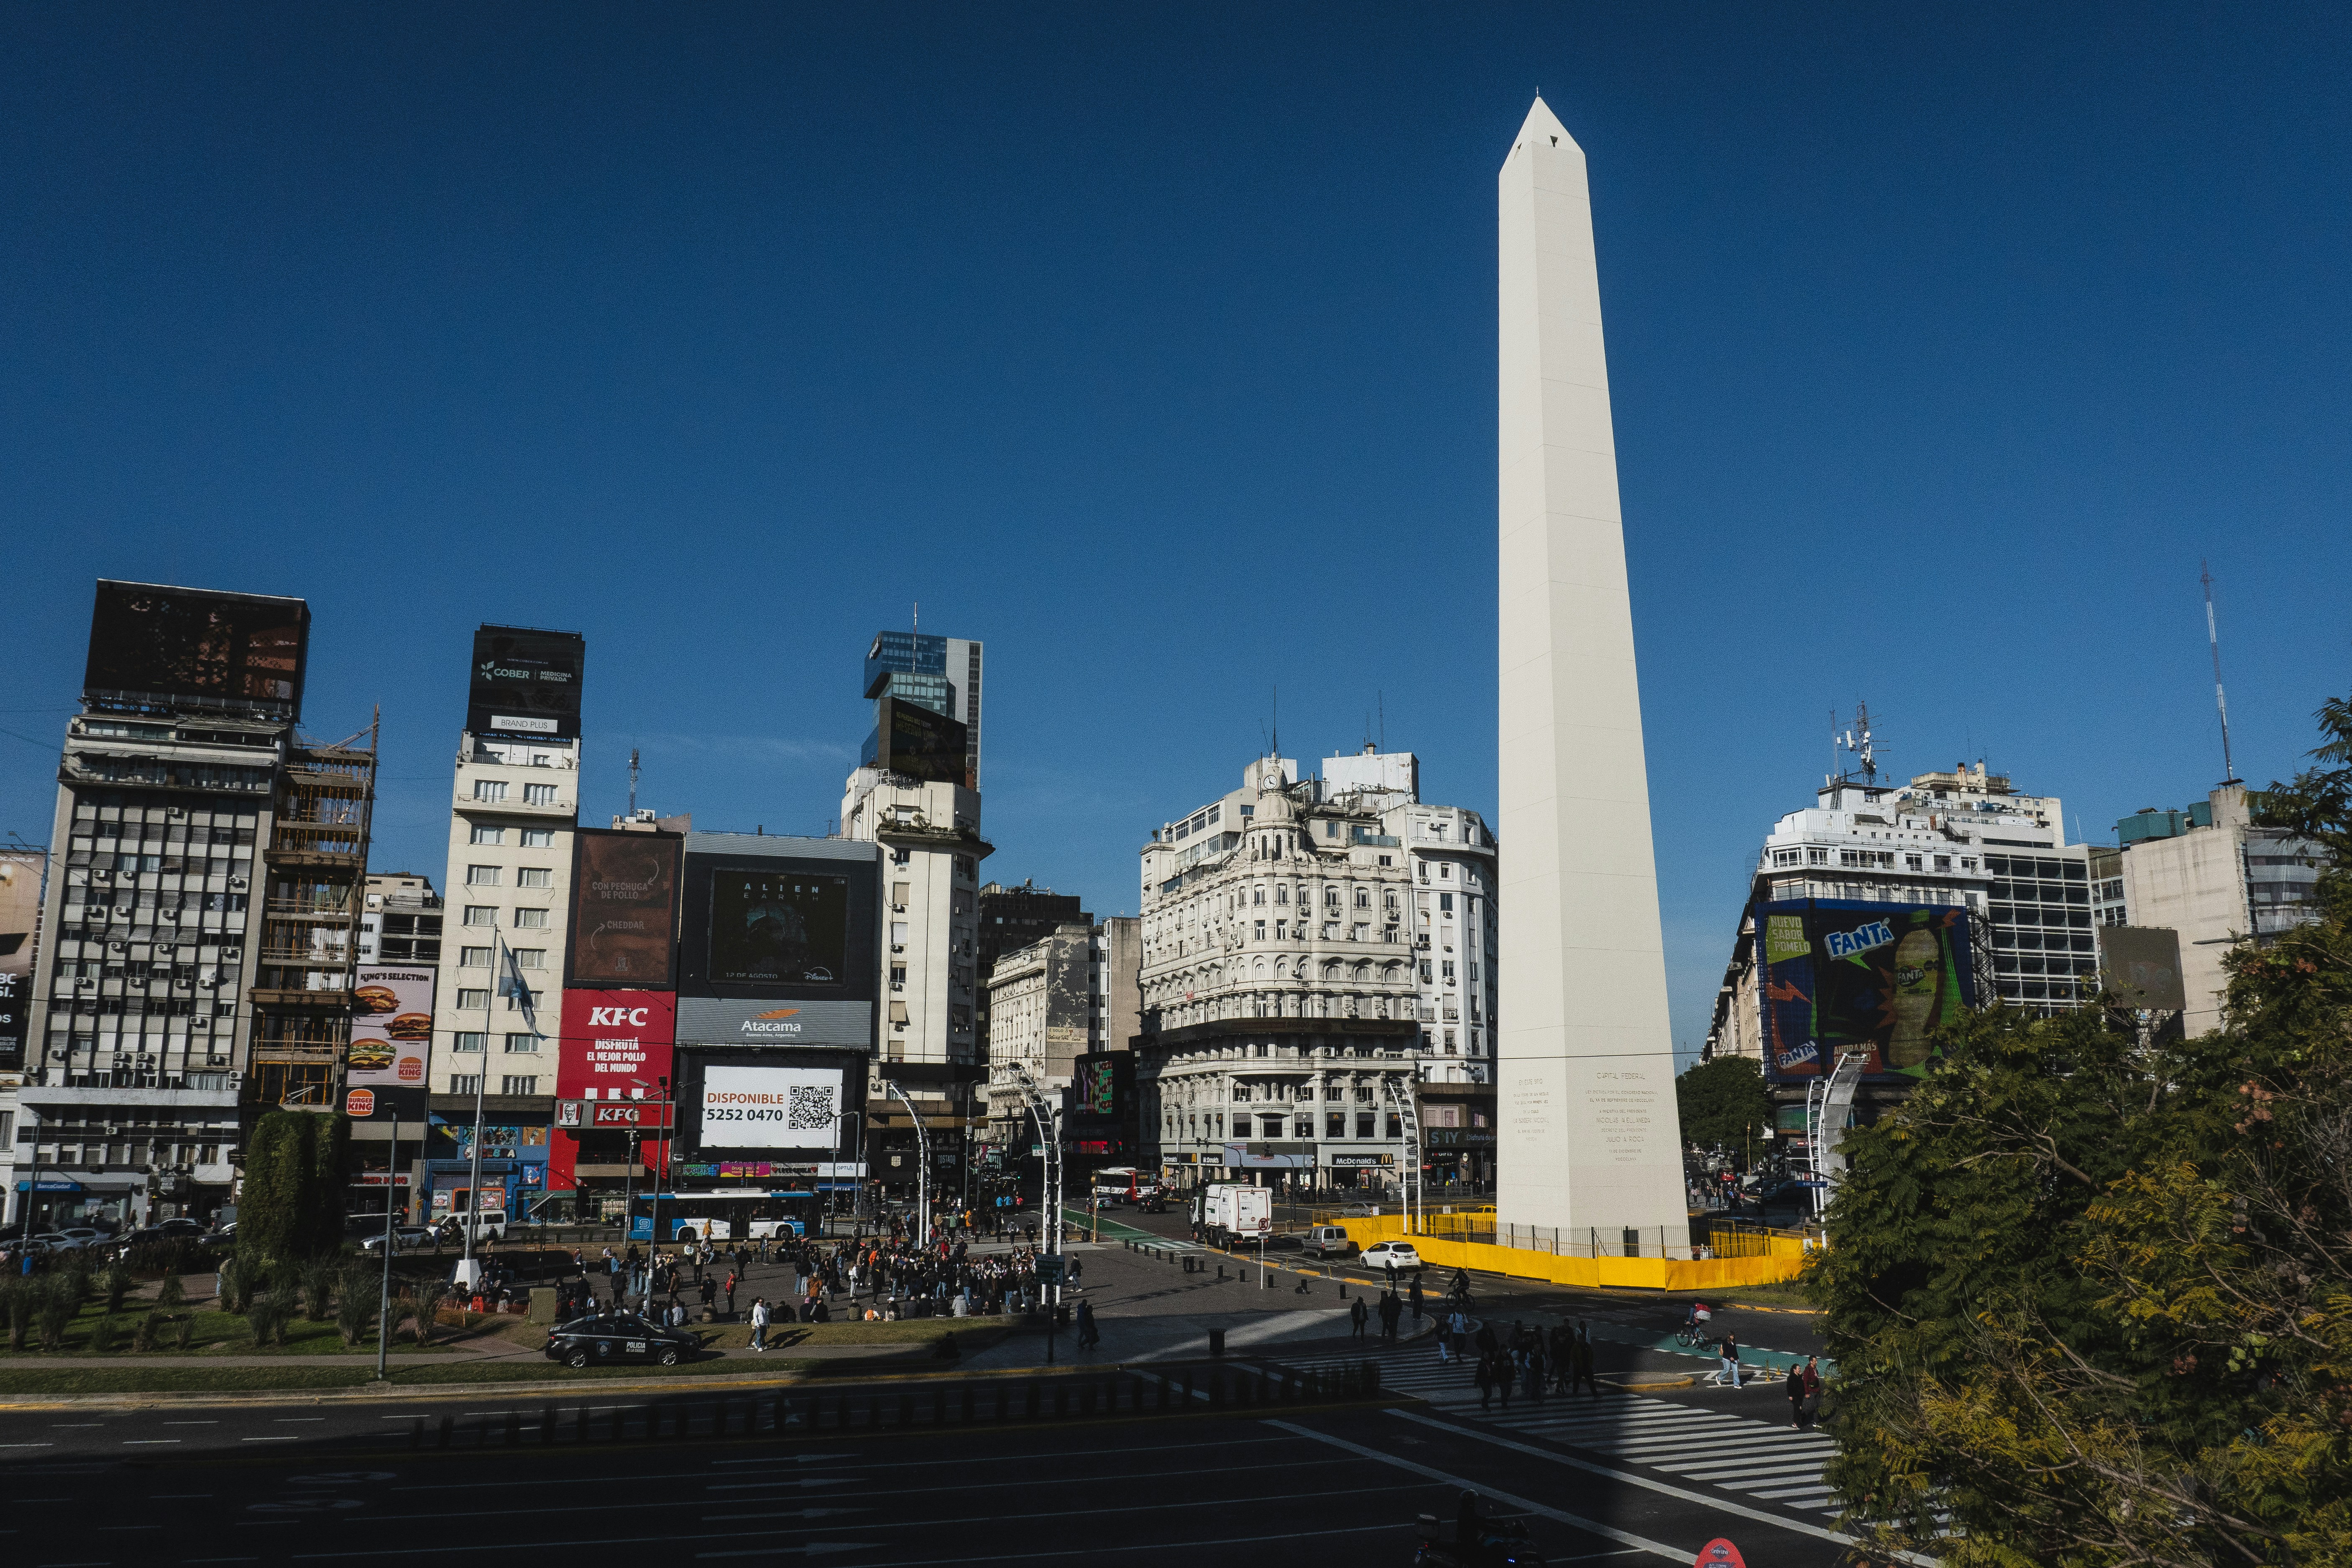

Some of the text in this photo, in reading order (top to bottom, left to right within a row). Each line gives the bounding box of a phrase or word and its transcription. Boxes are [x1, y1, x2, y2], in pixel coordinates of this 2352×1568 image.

[494, 668, 529, 679] COBER
[592, 881, 648, 891] CON PECHUGA
[744, 882, 819, 893] ALIEN
[613, 891, 639, 900] POLLO
[744, 893, 818, 901] EARTH
[607, 921, 645, 929] CHEDDAR
[1770, 917, 1802, 928] NUEVO
[1772, 929, 1802, 940] SABOR
[1829, 922, 1893, 957] FANTA
[1774, 941, 1810, 952] POMELO
[360, 972, 429, 982] KING'S SELECTION
[1897, 969, 1924, 983] FANTA
[588, 1007, 649, 1026] KFC
[741, 1021, 801, 1032] Atacama
[595, 1037, 639, 1050] DISFRUTÁ
[587, 1052, 646, 1062] EL MEJOR POLLO
[1778, 1046, 1815, 1066] FANTA
[595, 1063, 637, 1073] DEL MUNDO
[708, 1092, 784, 1104] DISPONIBLE
[597, 1108, 639, 1121] KFC
[707, 1109, 783, 1121] 5252 0470
[938, 1155, 956, 1165] TOSTADO
[639, 1219, 650, 1229] 9
